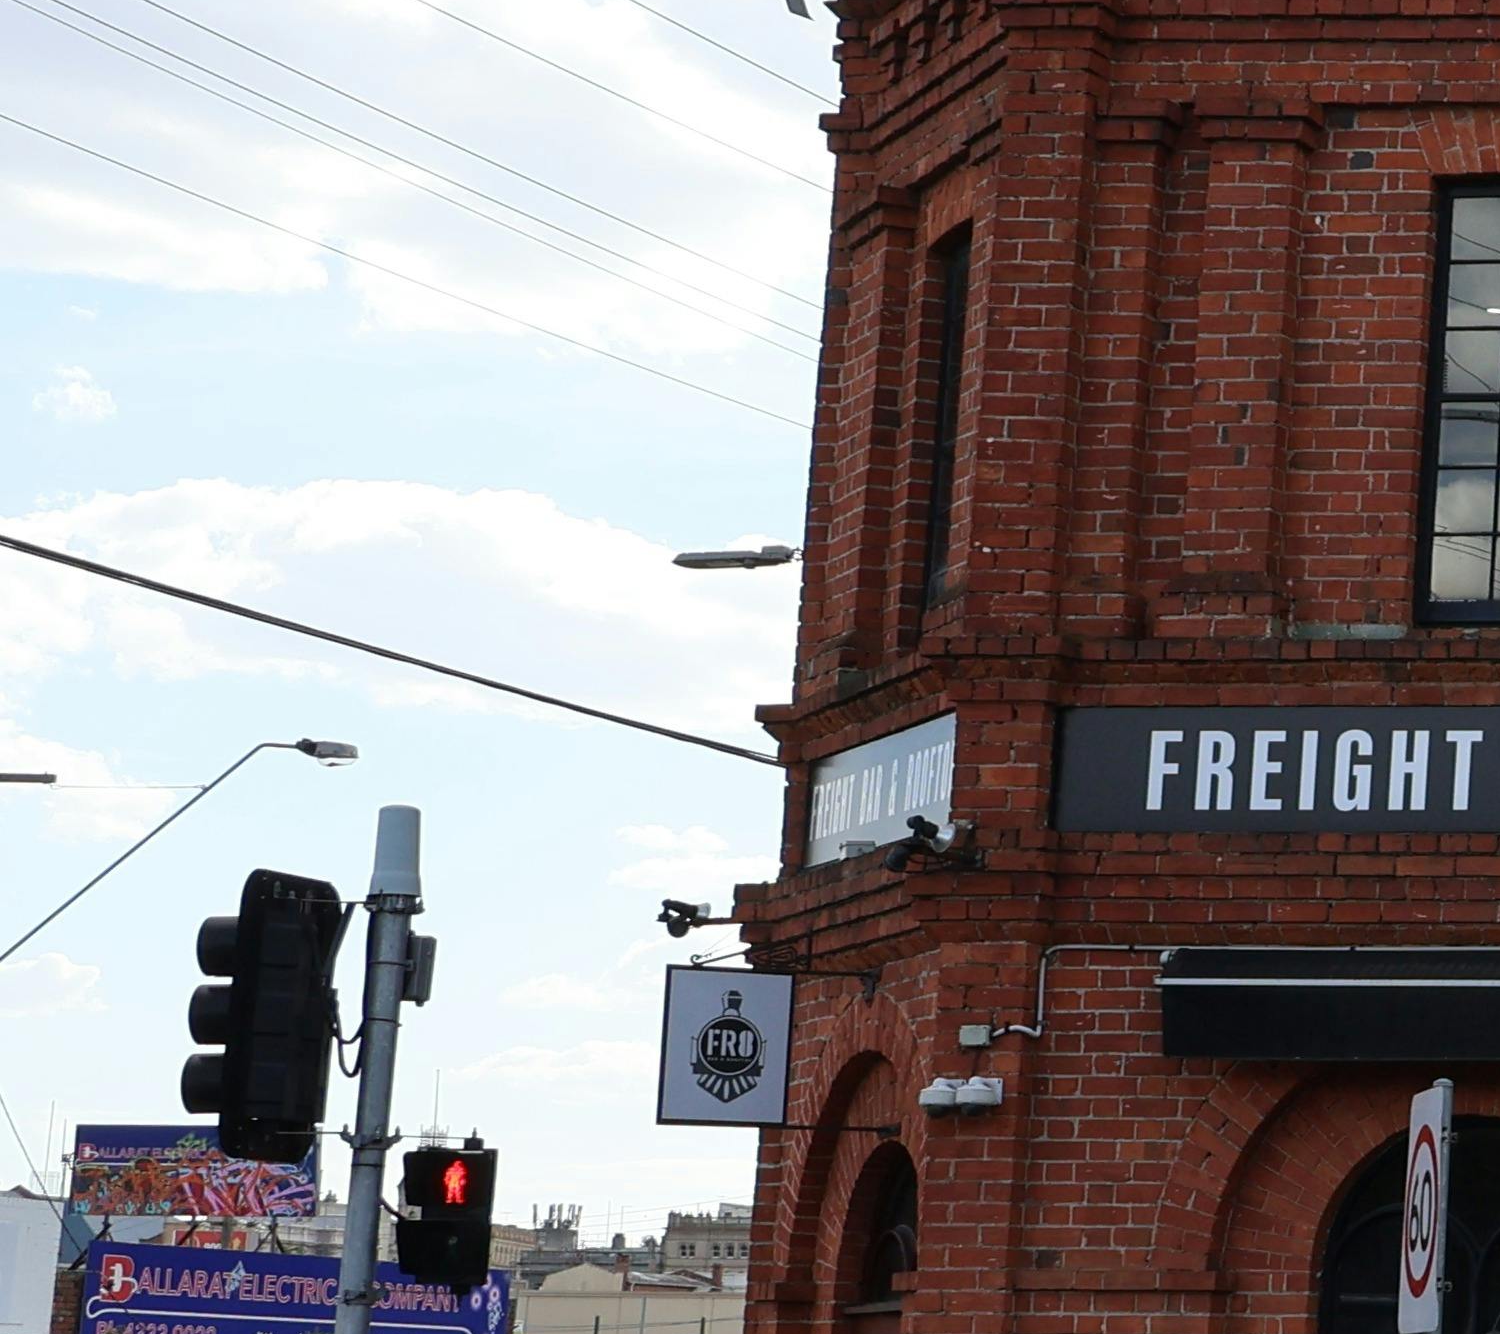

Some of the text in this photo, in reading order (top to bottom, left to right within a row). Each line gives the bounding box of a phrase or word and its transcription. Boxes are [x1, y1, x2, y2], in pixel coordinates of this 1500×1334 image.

[809, 773, 856, 843] FREIGHT
[858, 764, 883, 826] BAR
[887, 758, 898, 817] &
[1145, 729, 1484, 812] FREIGHT
[706, 1028, 755, 1058] FR8
[1409, 1170, 1433, 1253] 60
[100, 1254, 235, 1304] BALLARAT
[239, 1273, 340, 1306] ELECTRIC
